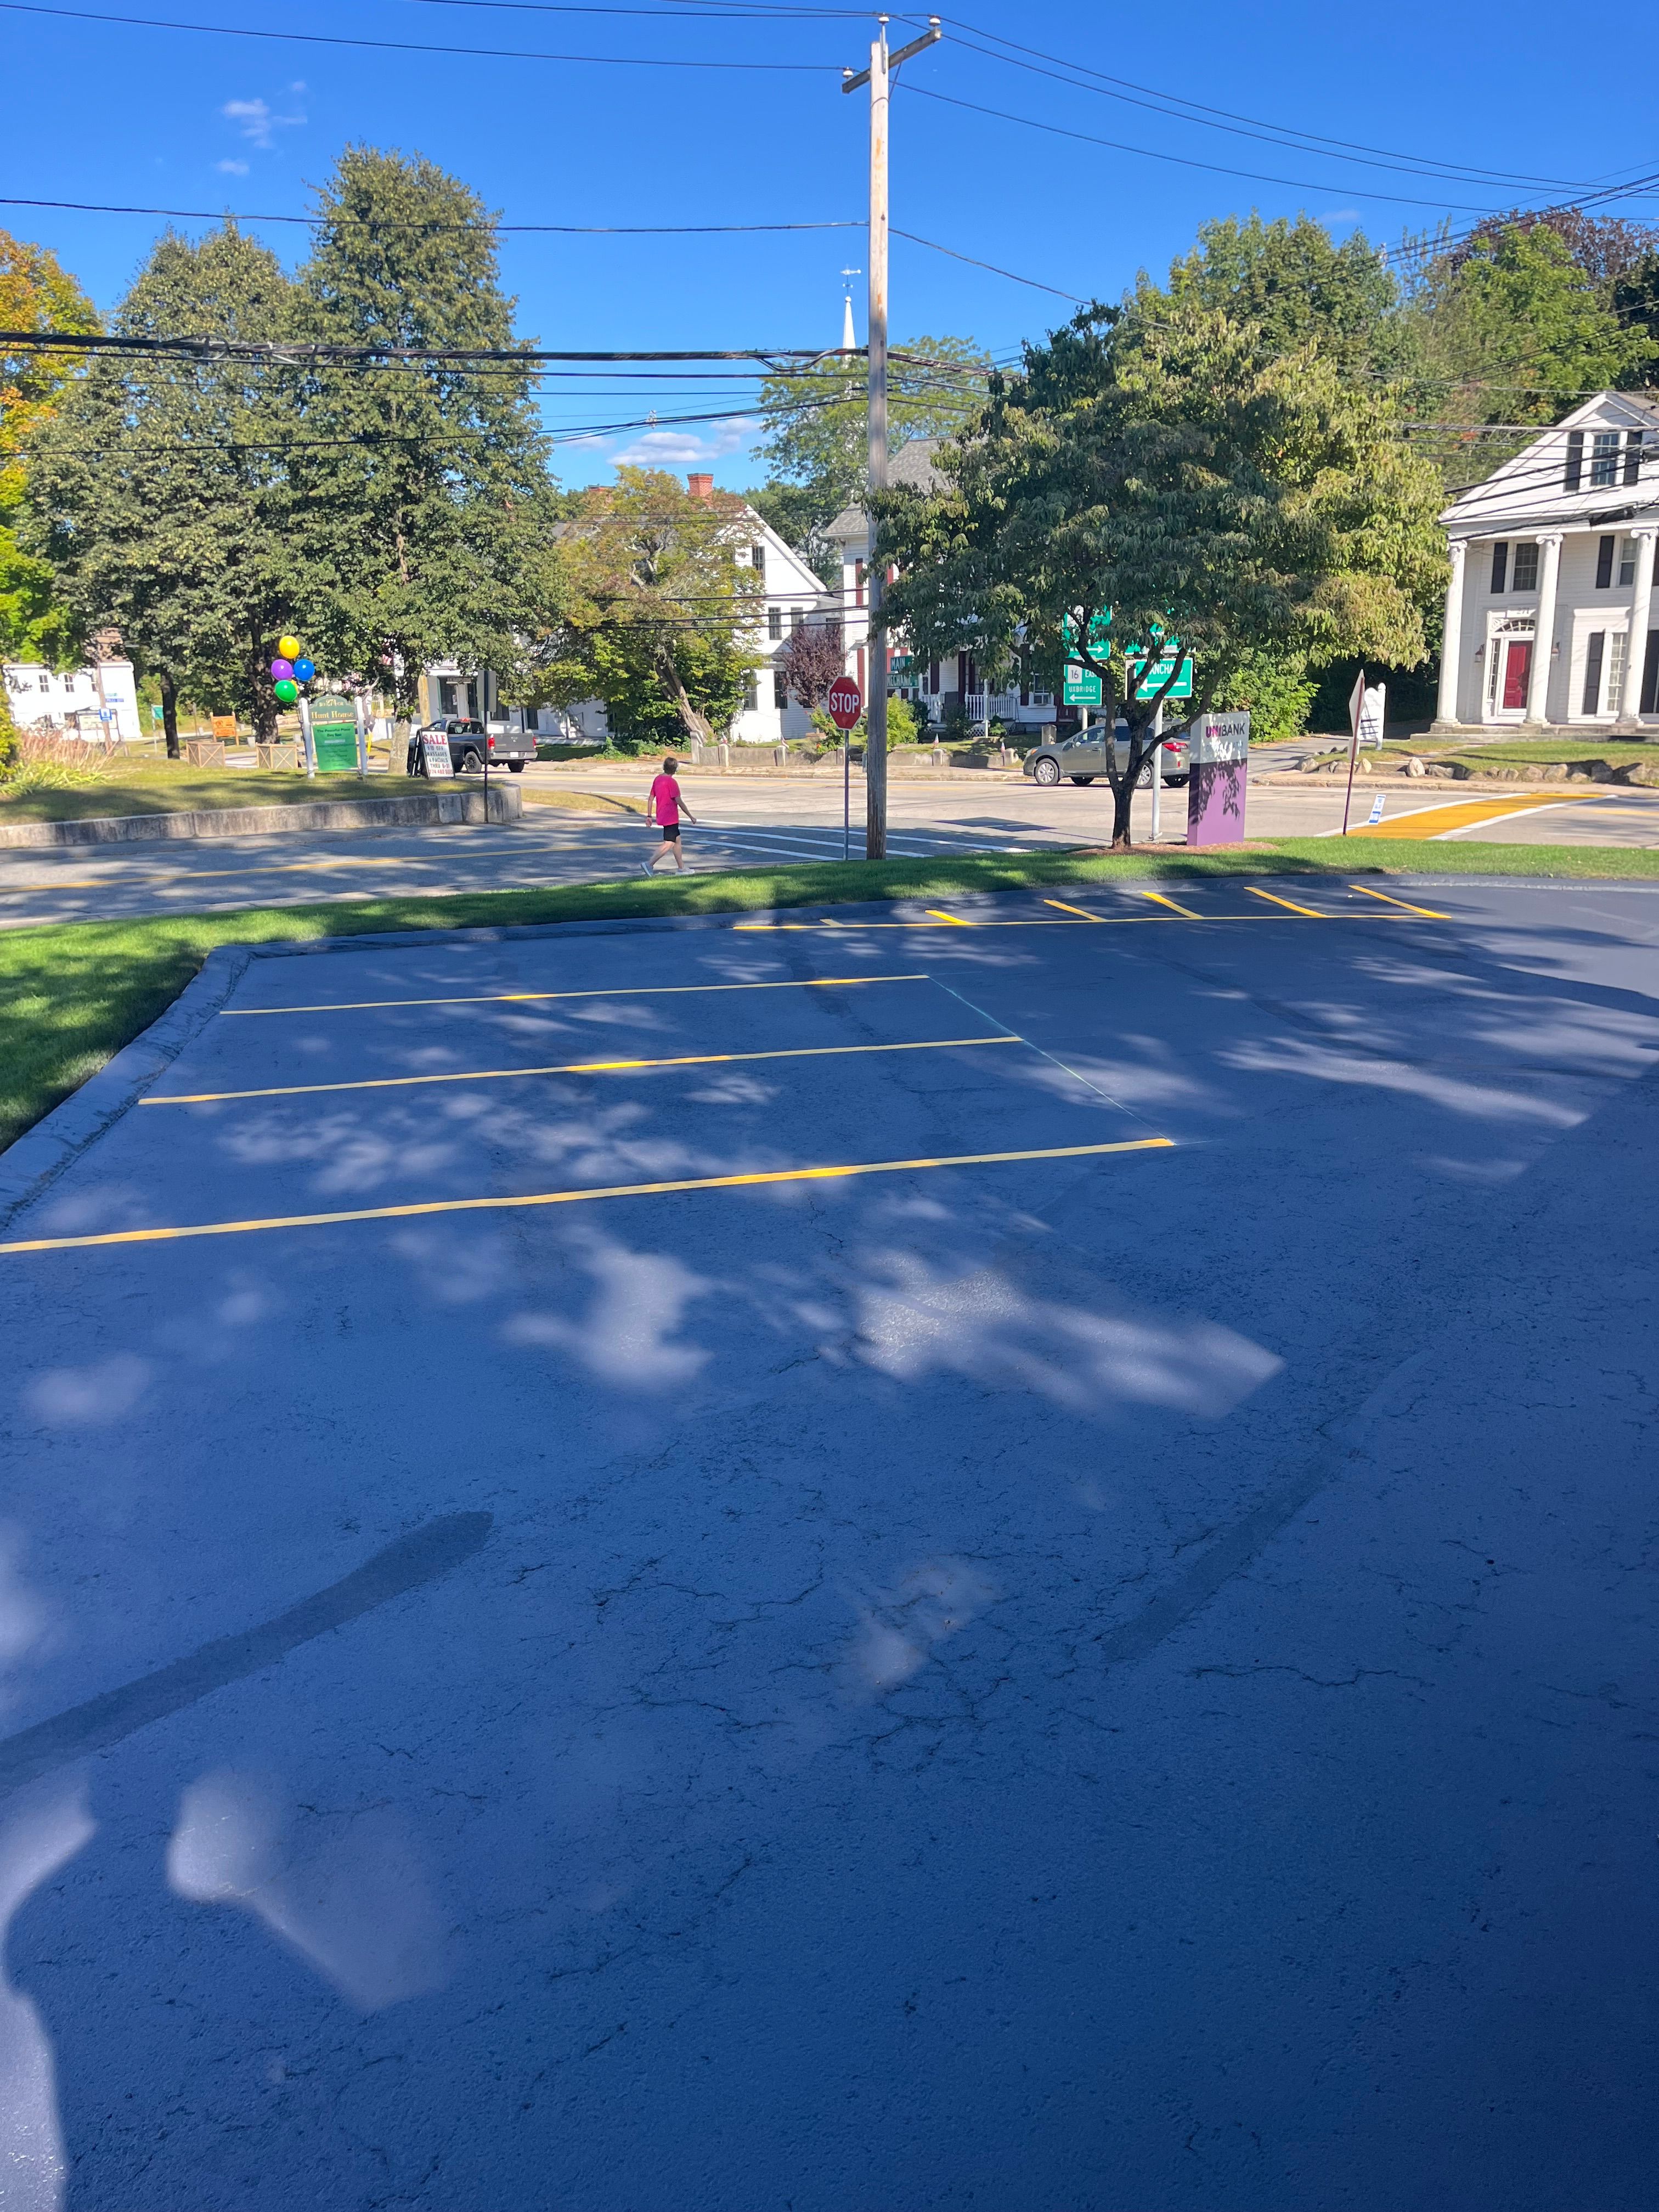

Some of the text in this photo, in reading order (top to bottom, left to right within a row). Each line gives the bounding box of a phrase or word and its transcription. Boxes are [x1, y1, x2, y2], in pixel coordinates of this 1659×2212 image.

[891, 657, 905, 670] MAIN
[887, 674, 912, 686] MECHANIC
[1071, 669, 1097, 679] 16 EAS
[831, 692, 859, 714] STOP
[1206, 723, 1245, 738] UNIBANK
[423, 735, 447, 744] SALE
